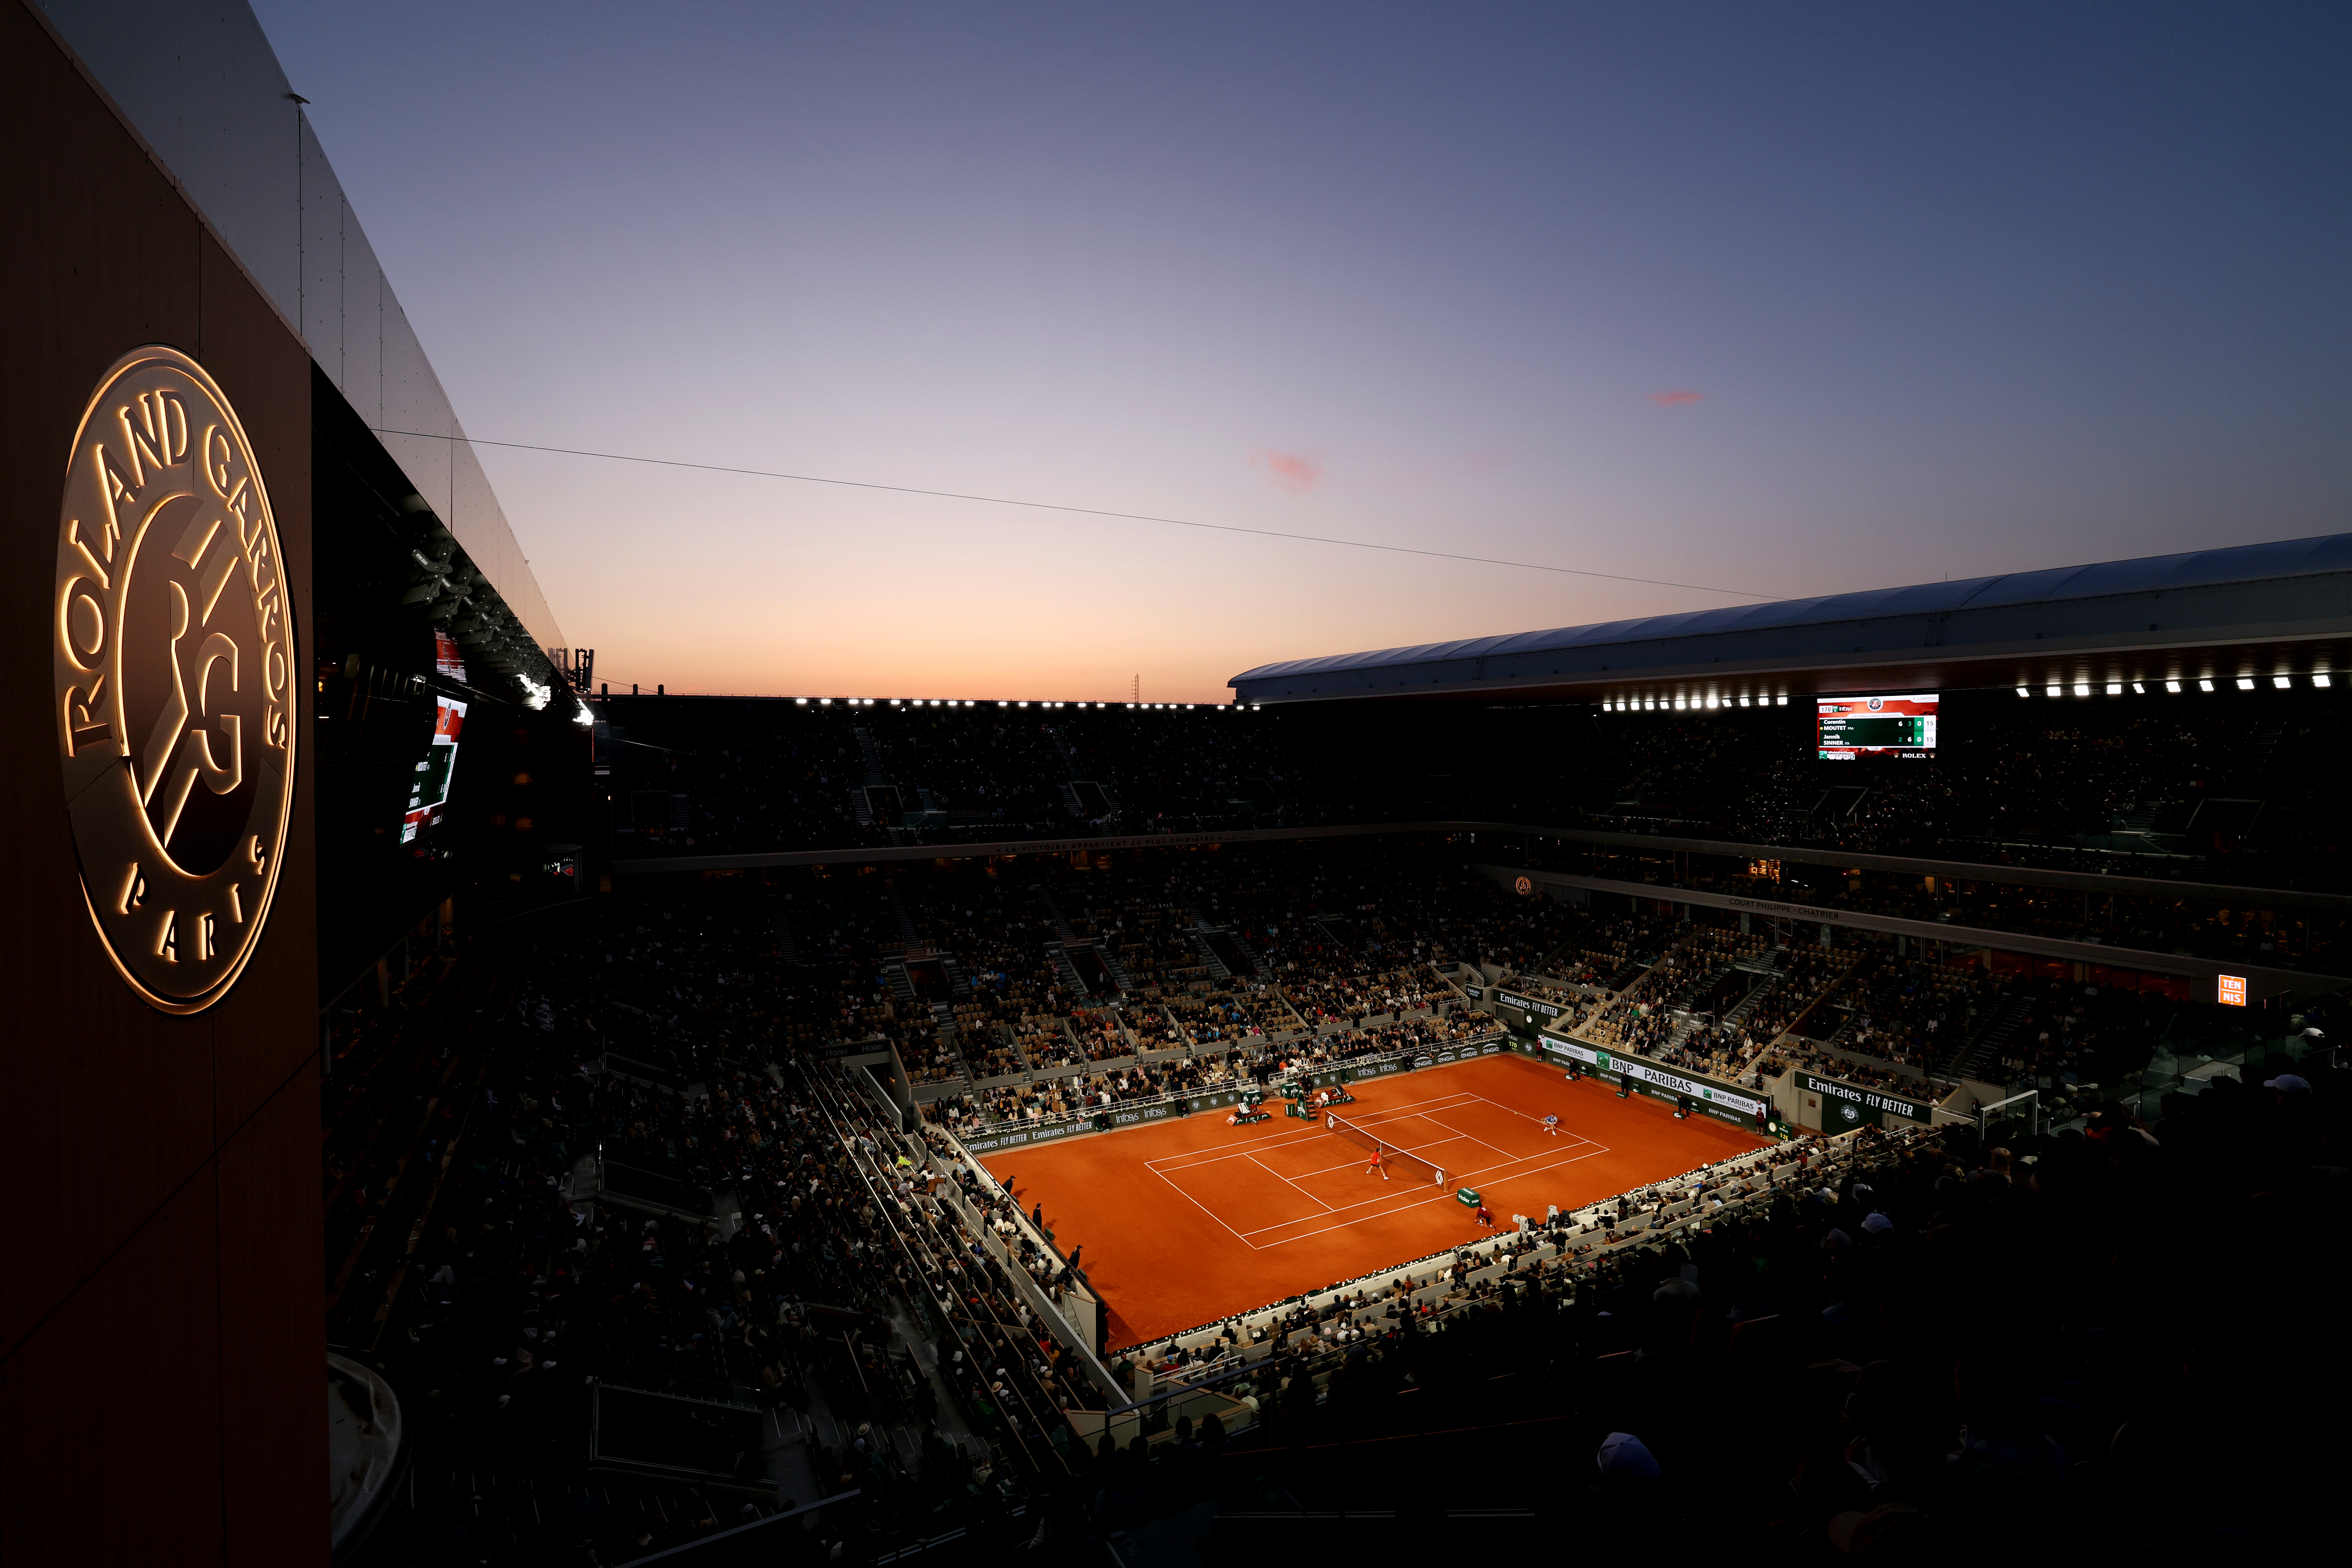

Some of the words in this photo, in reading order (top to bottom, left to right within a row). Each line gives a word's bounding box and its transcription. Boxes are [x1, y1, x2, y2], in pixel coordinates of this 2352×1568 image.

[63, 388, 192, 758] ROLAND
[203, 422, 288, 751] GARROS
[119, 834, 267, 963] PARIS
[1757, 902, 1791, 912] PHILIPPE
[1798, 908, 1839, 919] CHATRIER
[2223, 979, 2241, 990] TEN
[2223, 992, 2241, 1003] NIS
[1500, 993, 1530, 1009] Emirates
[1532, 1002, 1541, 1012] FLY
[1541, 1005, 1558, 1017] BETTER
[826, 1048, 847, 1057] Haier
[862, 1043, 883, 1052] Haier
[1564, 1046, 1583, 1056] PARIBAS
[1358, 1067, 1376, 1077] Infosys
[1379, 1063, 1397, 1073] Infosys
[1612, 1059, 1634, 1073] BNP
[1645, 1069, 1692, 1093] PARIBAS
[1662, 1093, 1678, 1102] PARIBA
[1728, 1097, 1754, 1109] PARIBAS
[1808, 1077, 1861, 1102] Emirates
[1866, 1094, 1881, 1107] FLY
[1882, 1098, 1913, 1117] BETTER
[1116, 1113, 1139, 1123] Infosys
[1144, 1108, 1167, 1118] Infosys
[1720, 1111, 1741, 1122] PARIBAS
[1032, 1127, 1065, 1139] Emirates
[1076, 1121, 1092, 1132] BETTER
[1010, 1133, 1027, 1144] BETTER
[1458, 1194, 1469, 1203] Haier
